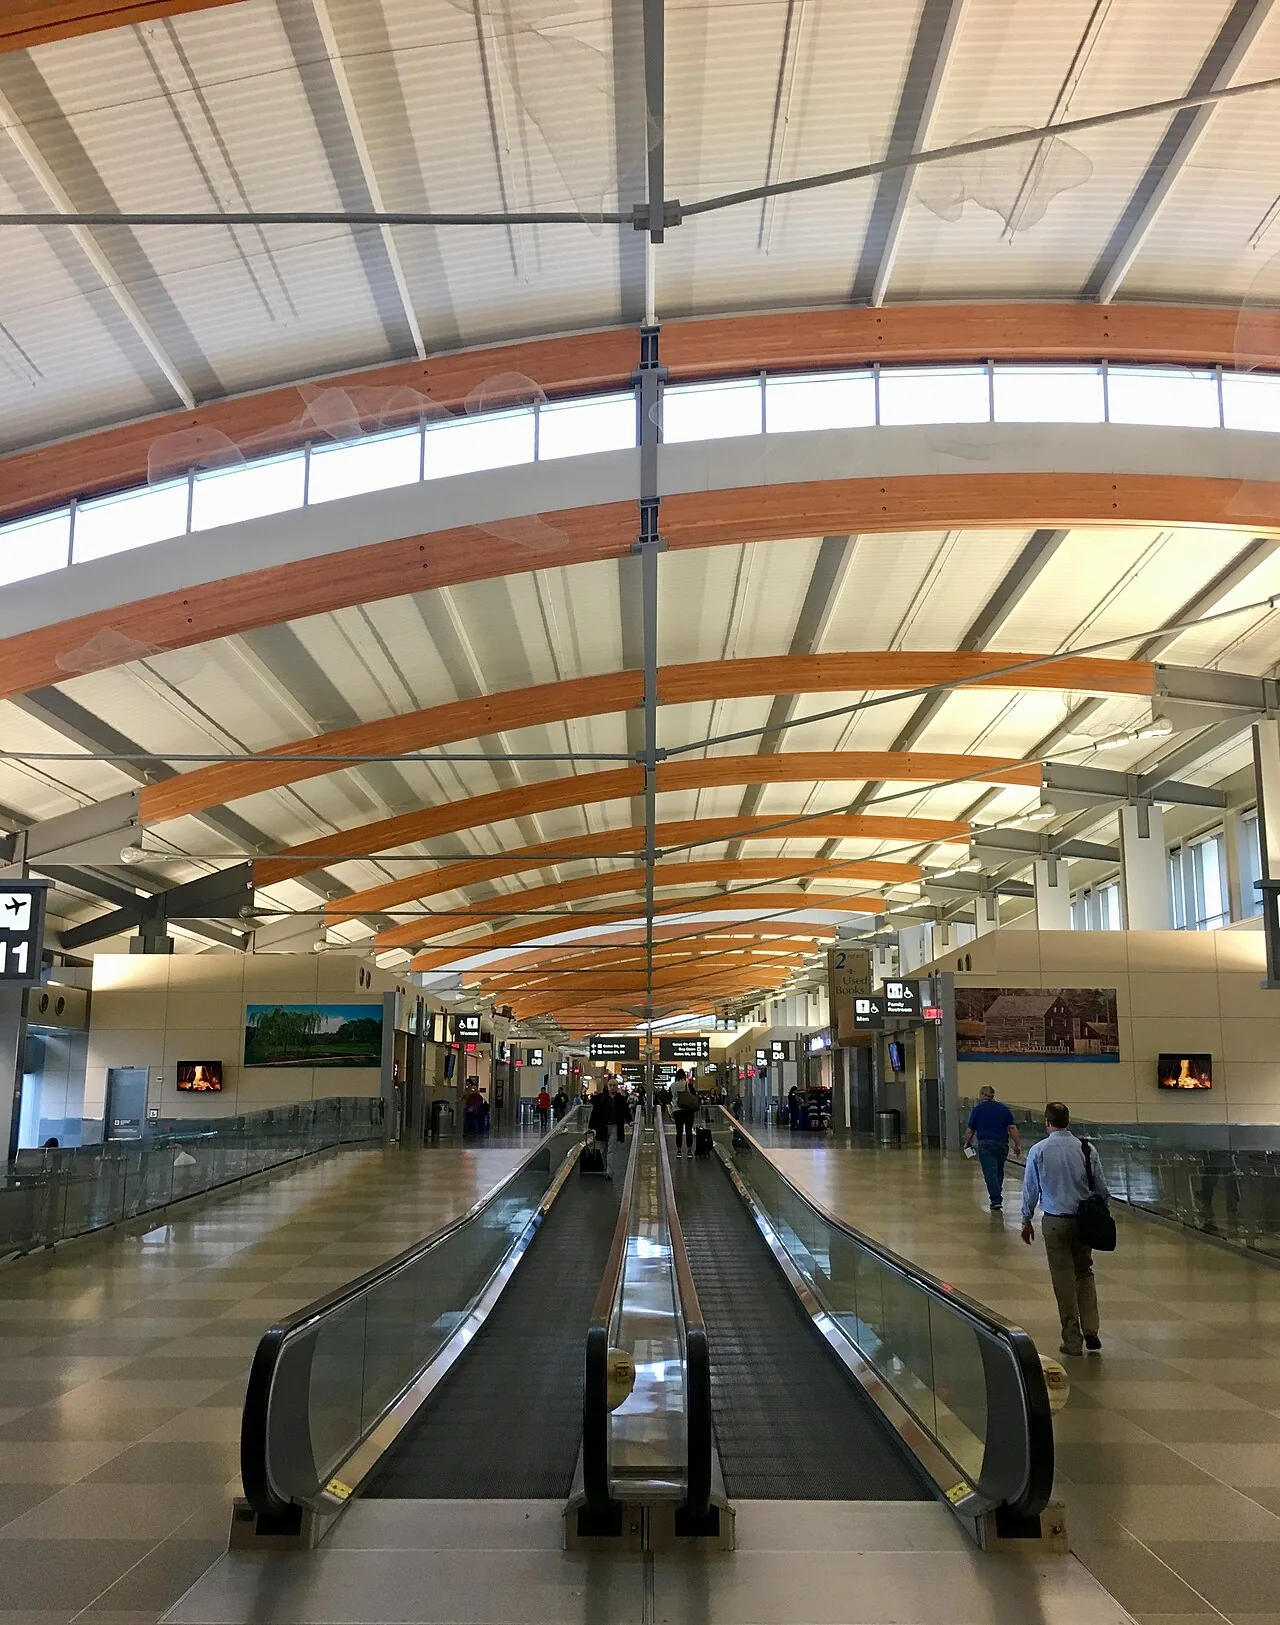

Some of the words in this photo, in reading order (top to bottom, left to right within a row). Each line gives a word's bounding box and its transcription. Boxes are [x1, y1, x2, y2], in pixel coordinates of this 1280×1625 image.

[843, 976, 867, 985] Used
[836, 985, 865, 995] Books
[772, 1052, 785, 1060] D8
